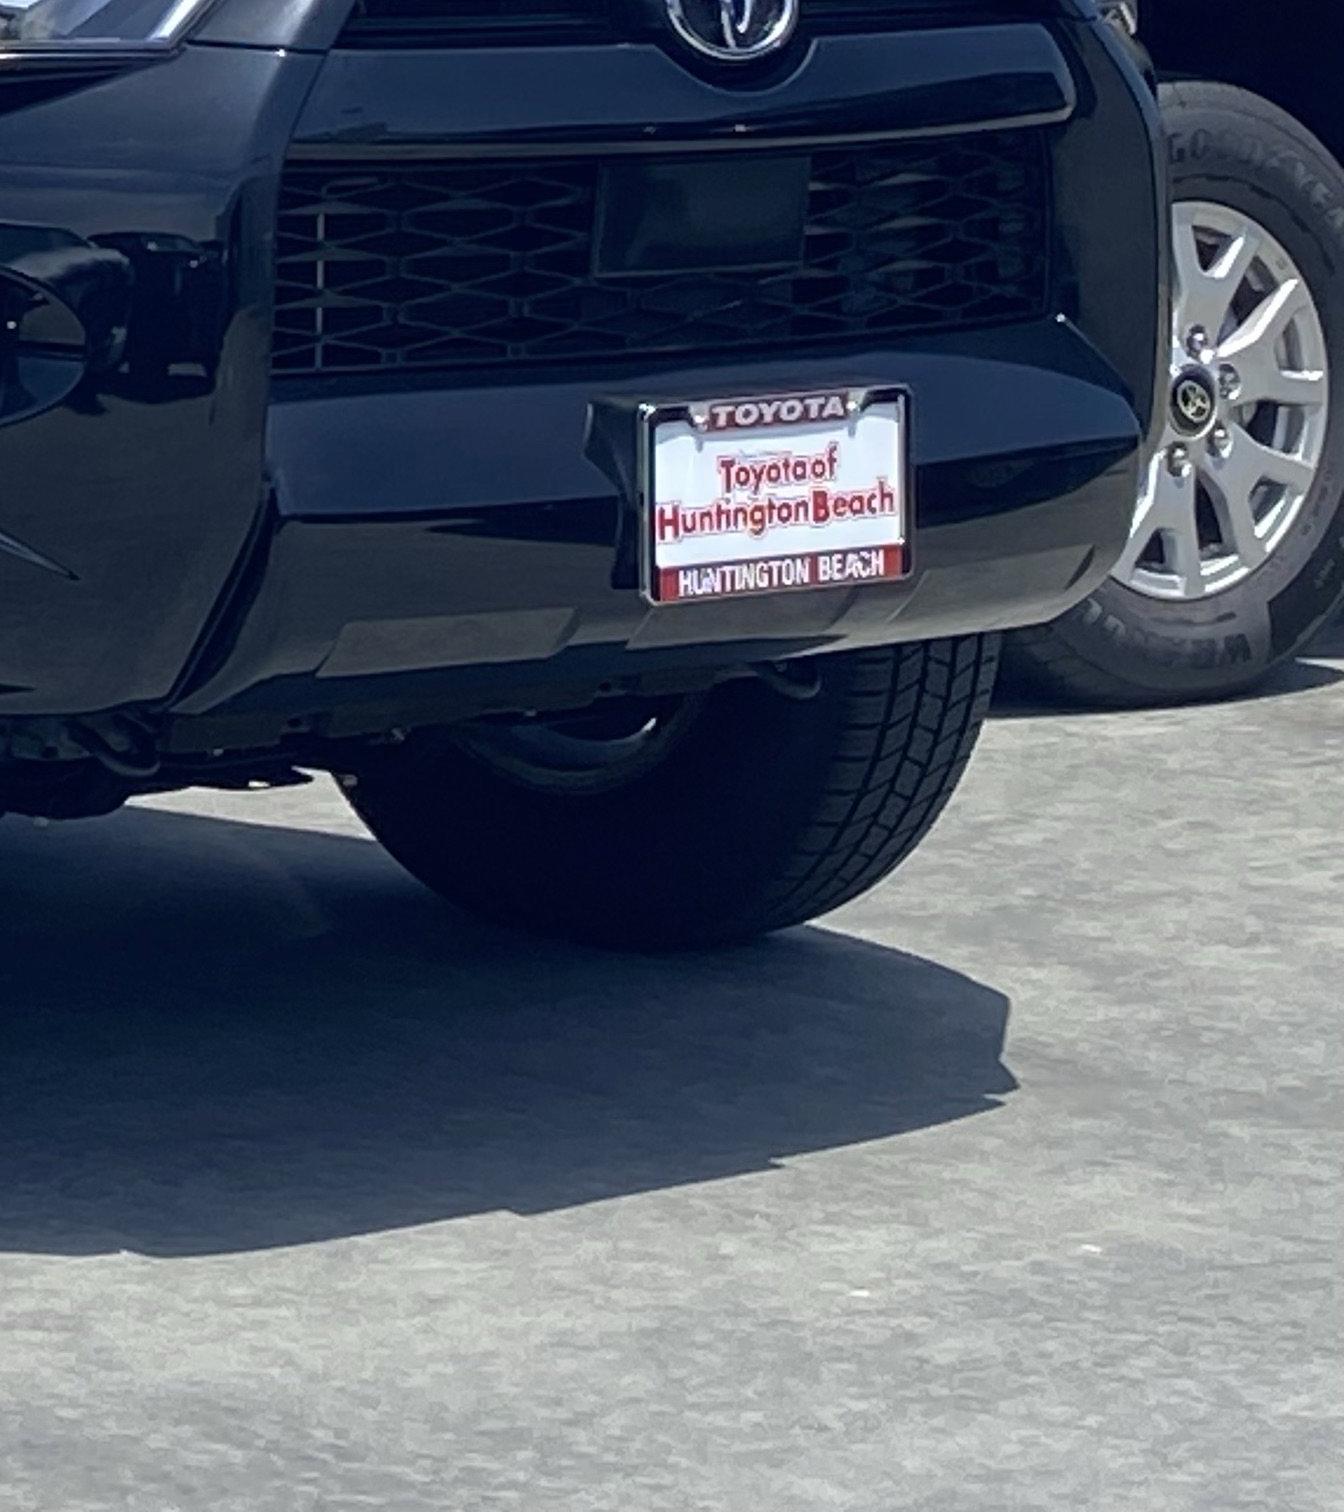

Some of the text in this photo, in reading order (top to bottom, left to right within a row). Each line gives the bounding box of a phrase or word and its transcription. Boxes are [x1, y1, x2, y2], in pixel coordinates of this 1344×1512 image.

[712, 394, 846, 429] TOYOTA
[719, 442, 838, 493] Toyota of
[657, 478, 895, 541] Huntington Beach
[678, 549, 885, 598] HUNTINGTON BEACH
